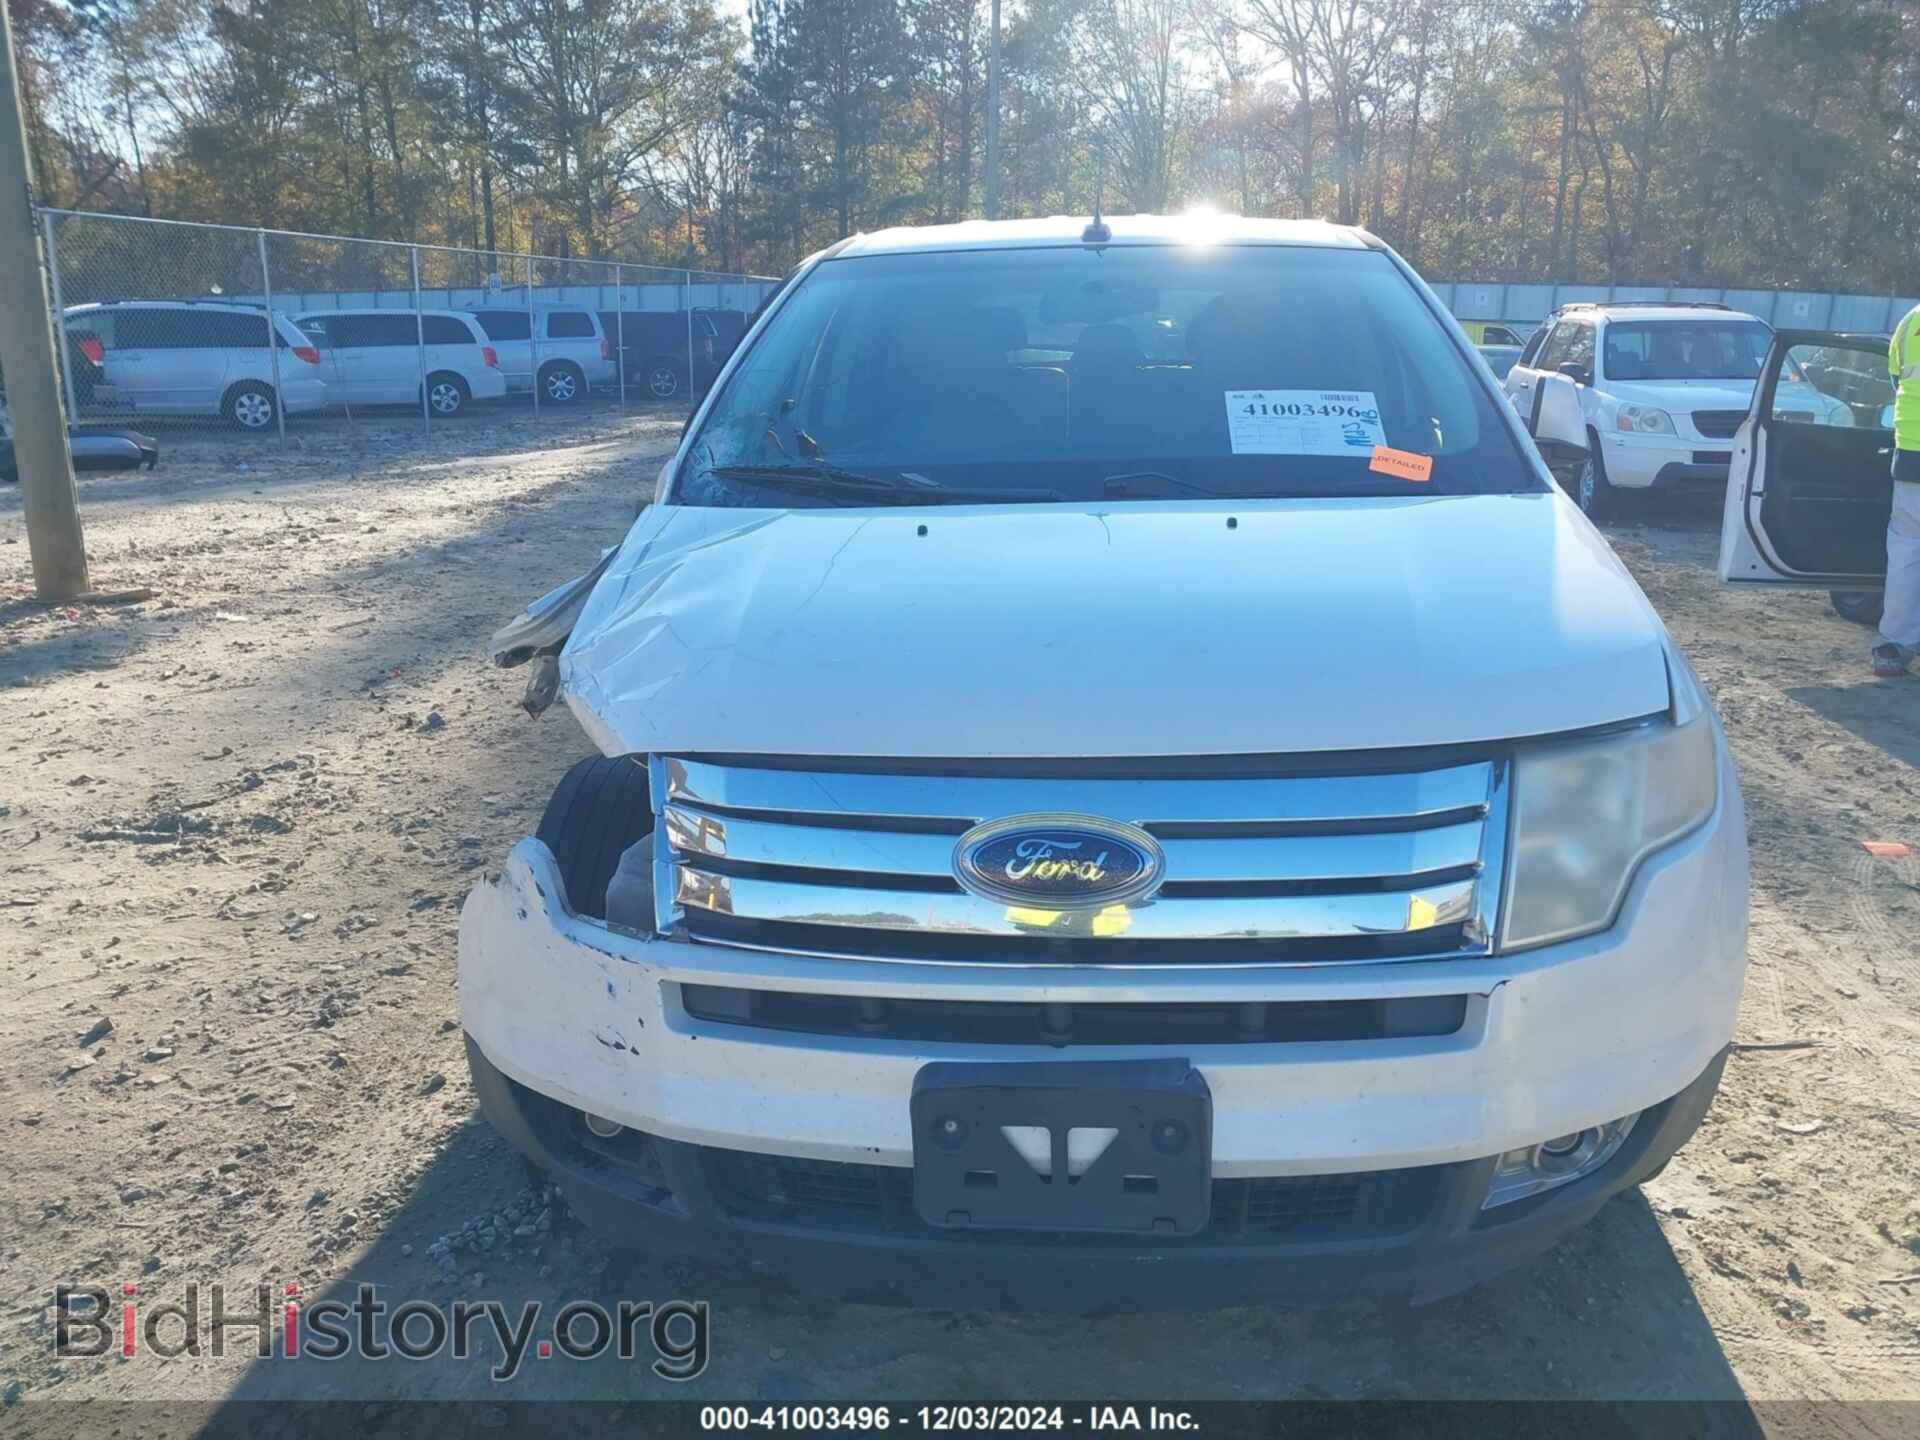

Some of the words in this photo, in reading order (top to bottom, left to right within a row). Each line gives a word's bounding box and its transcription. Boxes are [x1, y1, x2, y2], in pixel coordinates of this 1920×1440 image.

[1242, 403, 1361, 418] 41003496
[1377, 454, 1426, 472] DETAILED
[1006, 838, 1108, 881] Ford
